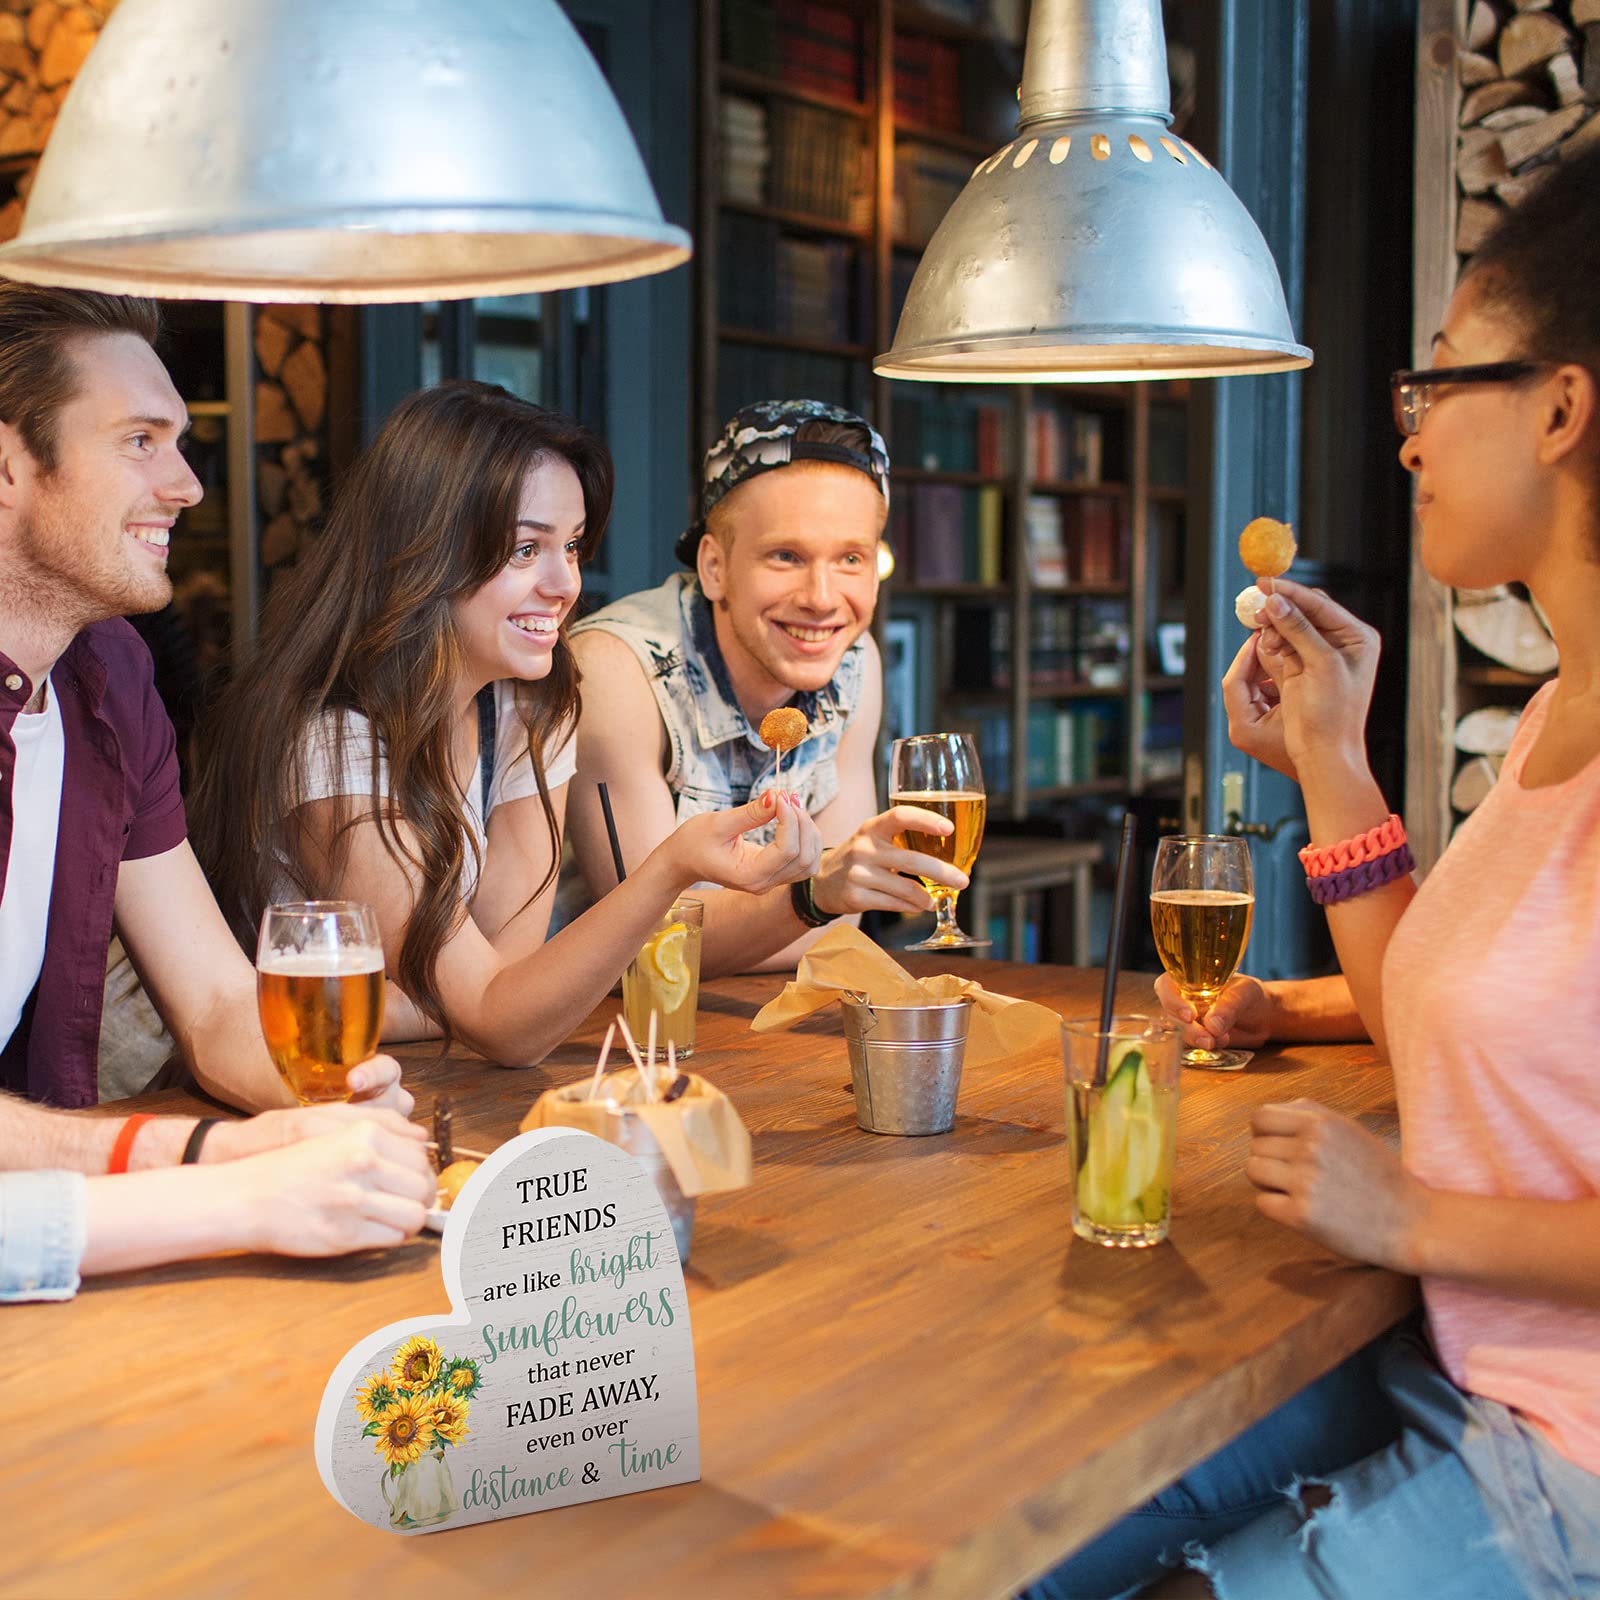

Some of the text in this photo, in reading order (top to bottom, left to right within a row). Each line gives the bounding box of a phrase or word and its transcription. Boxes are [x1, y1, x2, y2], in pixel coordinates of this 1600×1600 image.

[517, 1168, 587, 1203] TRUE
[502, 1204, 616, 1249] FRIENDS
[483, 1231, 663, 1301] are like bright
[528, 1350, 635, 1384] that never
[506, 1375, 660, 1428] FADE AWAY,
[527, 1417, 628, 1453] even over
[463, 1437, 682, 1510] distance & time
